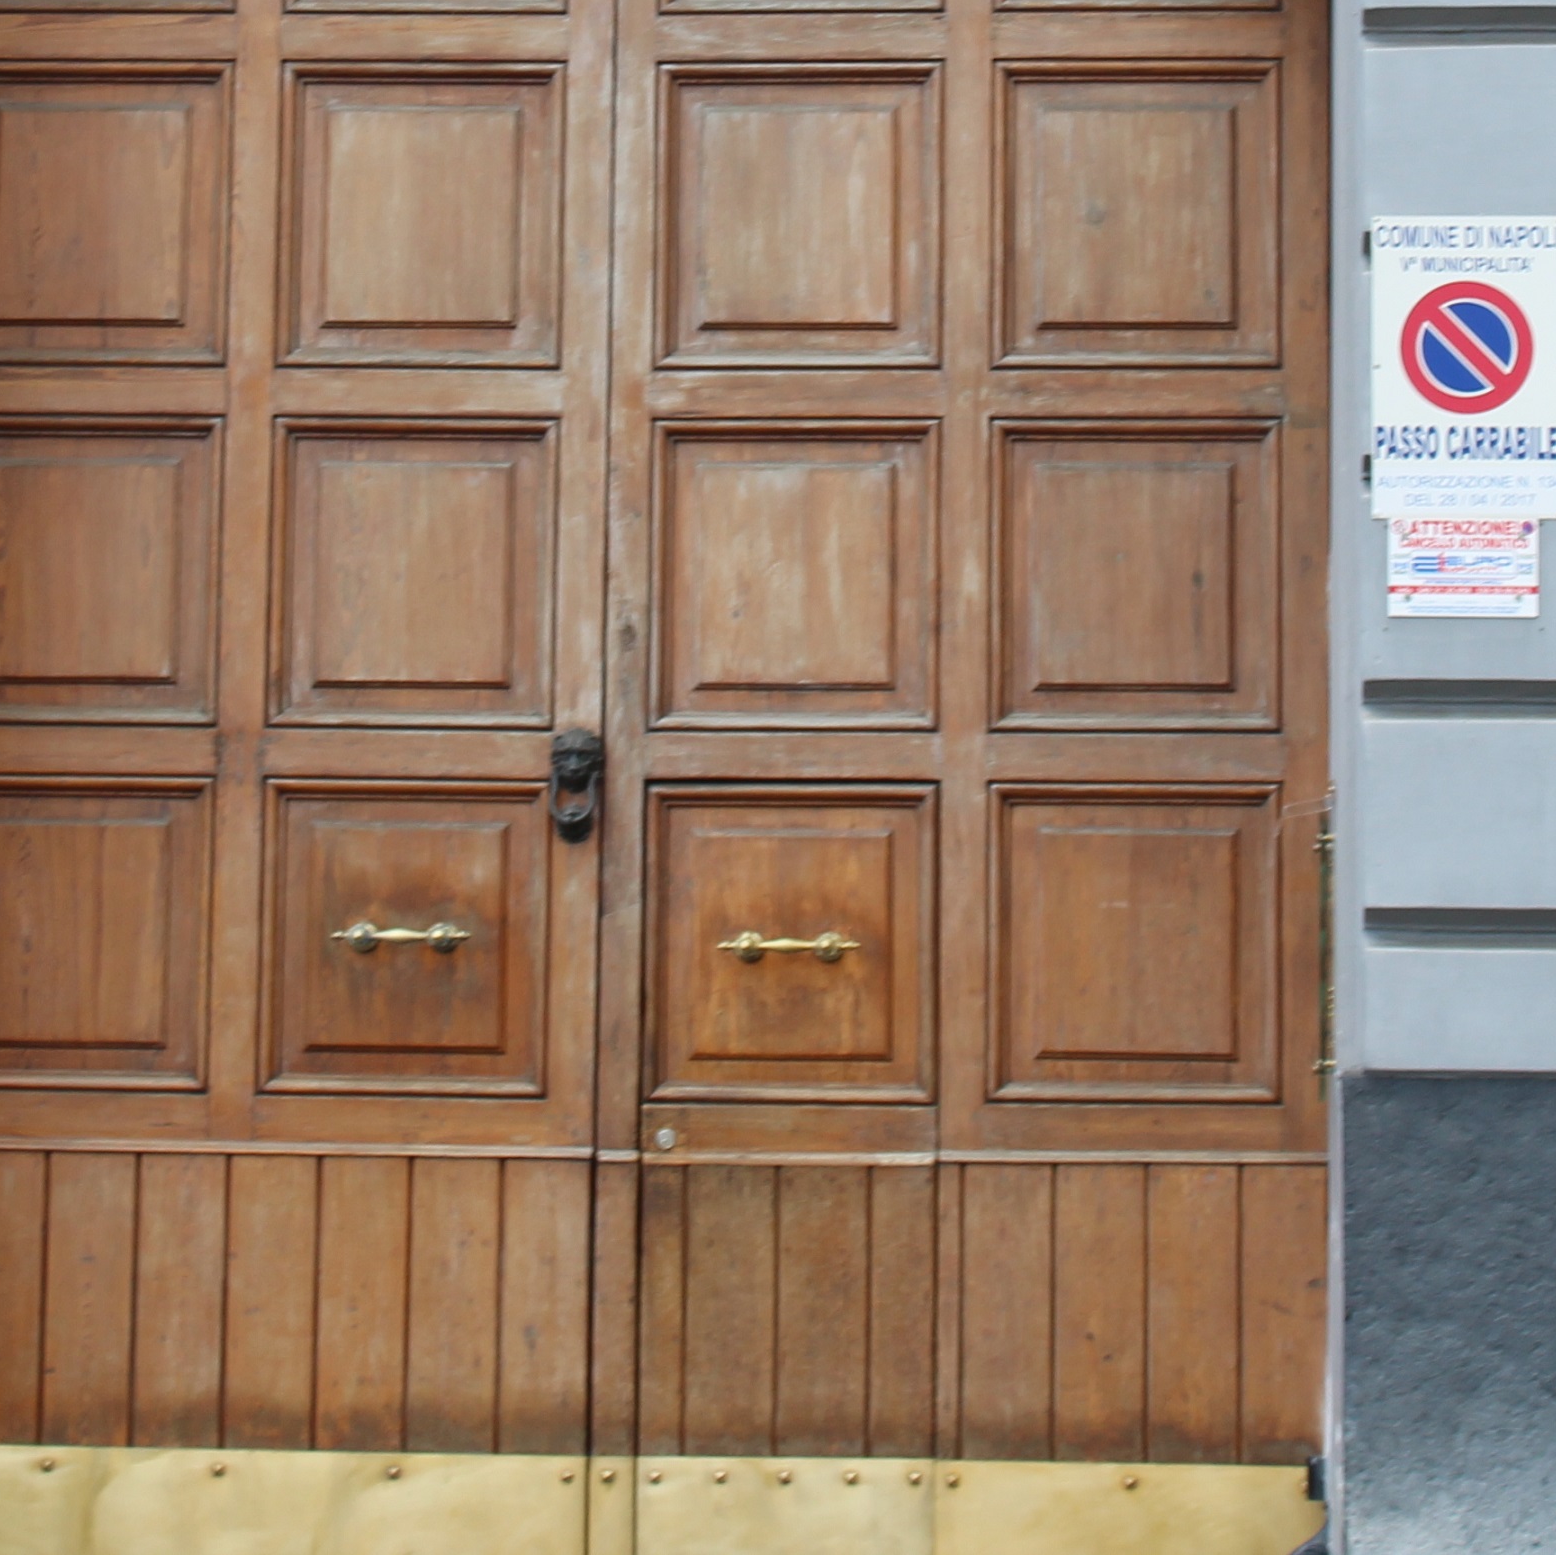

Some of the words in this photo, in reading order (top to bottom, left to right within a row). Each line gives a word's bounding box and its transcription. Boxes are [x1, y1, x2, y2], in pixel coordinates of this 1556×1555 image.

[1374, 225, 1459, 248] COMUNE
[1463, 225, 1483, 248] DI
[1374, 425, 1441, 460] PASSO
[1376, 475, 1514, 489] AUTORIZZAZIONE
[1404, 493, 1434, 507] DEL
